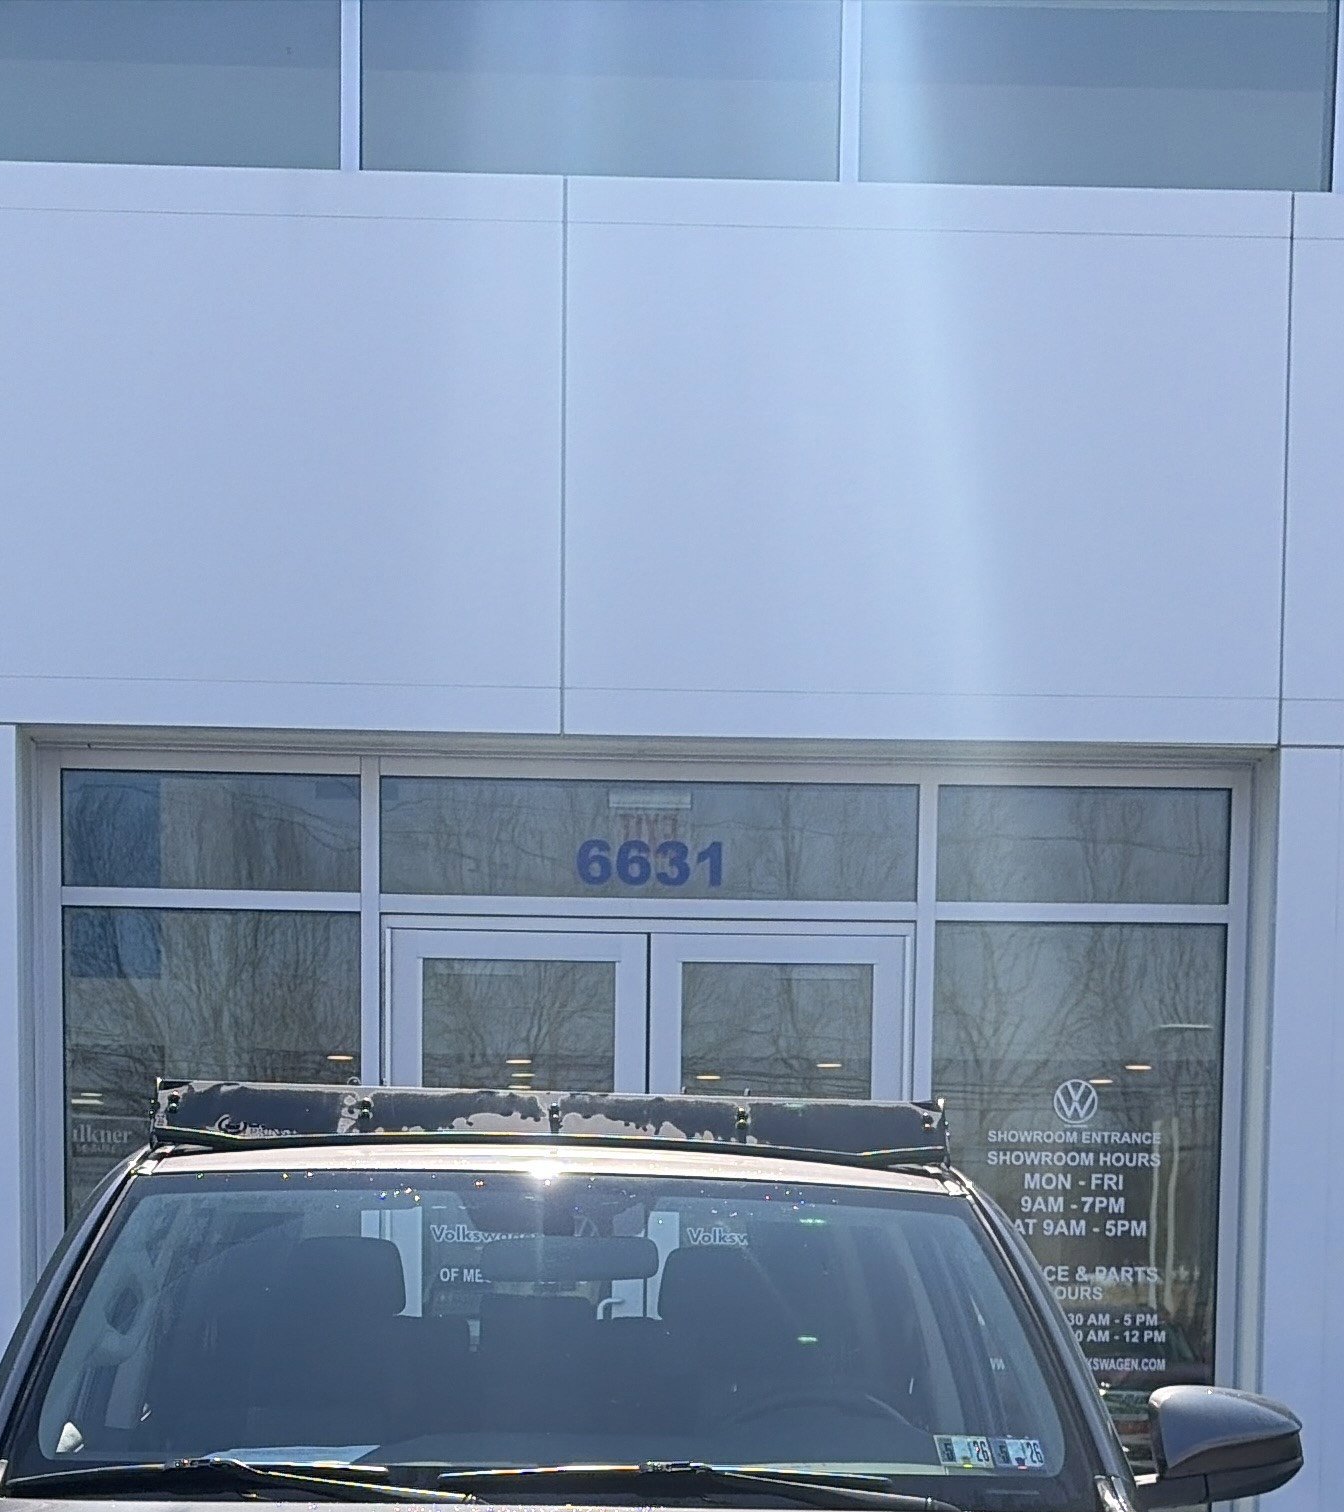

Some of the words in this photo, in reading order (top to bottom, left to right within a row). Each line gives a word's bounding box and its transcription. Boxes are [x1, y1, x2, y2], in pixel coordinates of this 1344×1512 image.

[576, 838, 723, 887] 6631
[987, 1130, 1078, 1144] SHOWROOM
[1081, 1131, 1161, 1145] ENTRANCE
[987, 1151, 1094, 1166] SHOWROOM
[1099, 1152, 1161, 1167] HOURS
[1024, 1172, 1072, 1190] MON
[1090, 1173, 1124, 1190] FRI
[1020, 1197, 1064, 1213] 9AM
[1081, 1197, 1125, 1213] 7PM
[1012, 1218, 1037, 1236] AT
[1042, 1219, 1086, 1236] 9AM
[1105, 1219, 1147, 1237] 5PM
[687, 1227, 749, 1245] Volksw
[439, 1267, 459, 1283] OF
[1075, 1265, 1088, 1282] &
[1095, 1266, 1158, 1283] PARTS
[1055, 1285, 1103, 1301] OURS
[1087, 1313, 1110, 1327] AM
[1123, 1313, 1132, 1327] 5
[1136, 1313, 1158, 1327] PM
[1087, 1330, 1110, 1343] AM
[1123, 1330, 1139, 1343] 12
[1143, 1331, 1167, 1344] PM
[1086, 1357, 1167, 1372] KSWAGEN.COM
